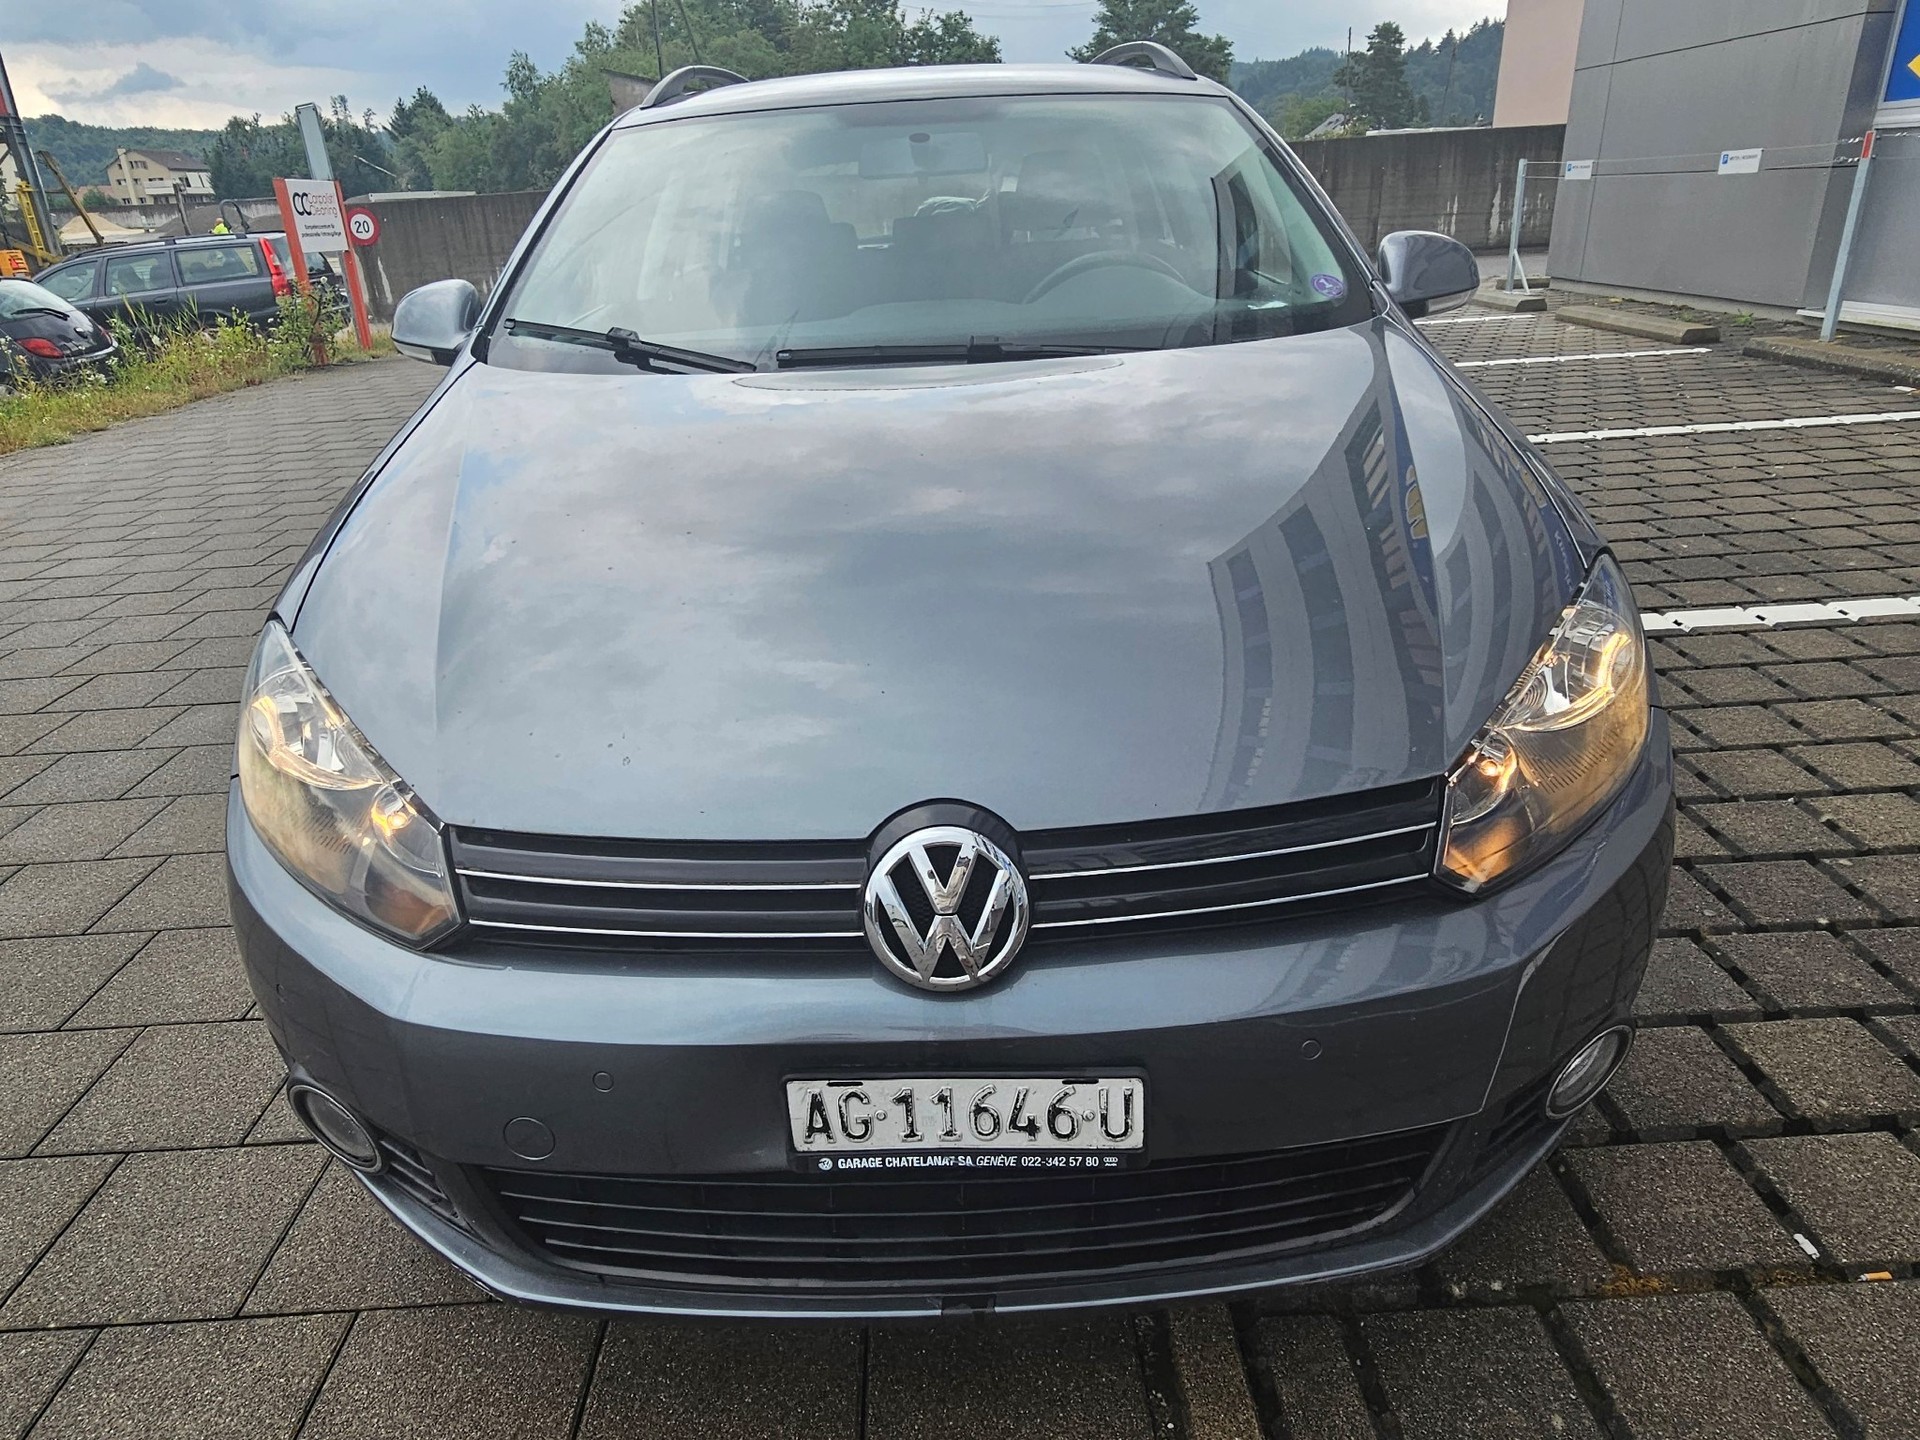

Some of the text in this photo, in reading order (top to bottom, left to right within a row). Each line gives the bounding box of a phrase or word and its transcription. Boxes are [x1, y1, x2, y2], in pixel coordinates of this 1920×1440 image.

[354, 220, 370, 233] 20
[838, 1157, 883, 1169] GARAGE
[957, 1155, 973, 1167] SA
[976, 1154, 1018, 1166] GENÈVE
[1021, 1156, 1067, 1167] 022-342
[1069, 1156, 1082, 1167] 57
[1085, 1156, 1099, 1167] 80
